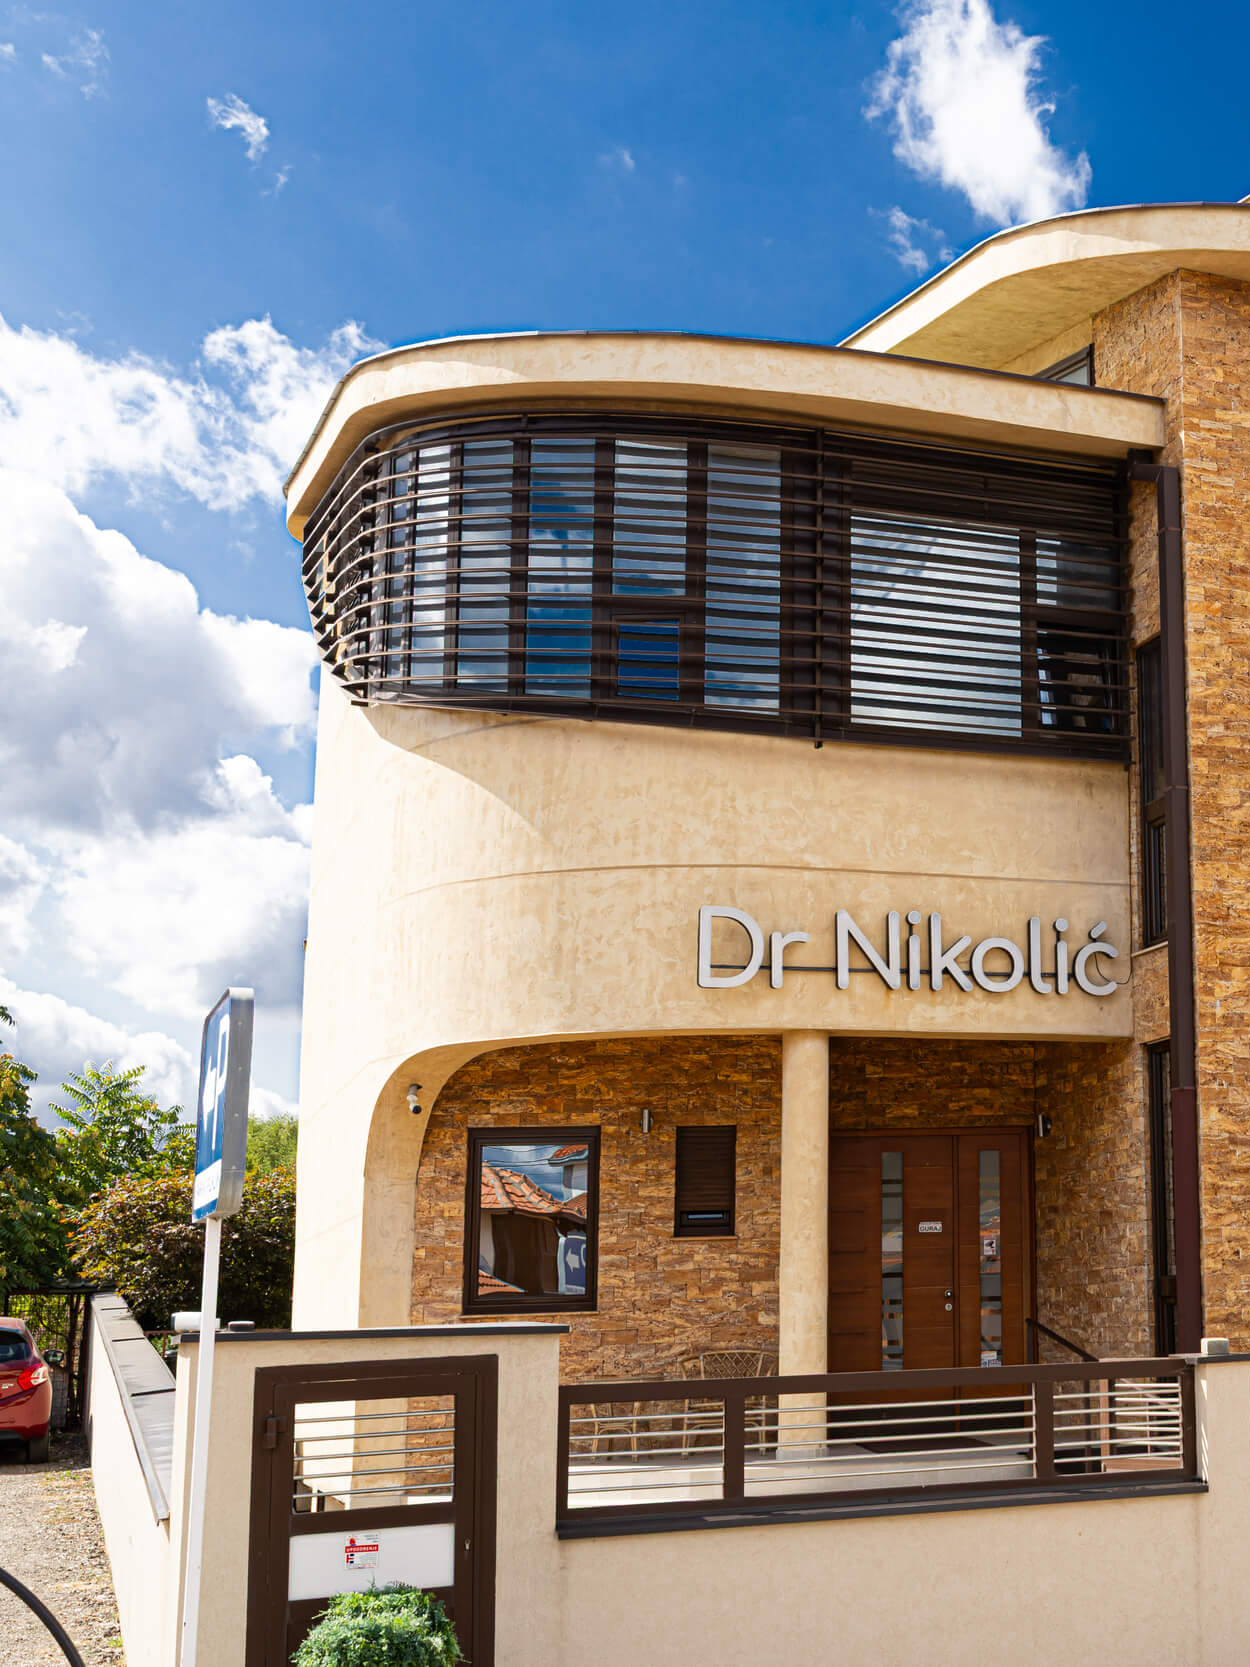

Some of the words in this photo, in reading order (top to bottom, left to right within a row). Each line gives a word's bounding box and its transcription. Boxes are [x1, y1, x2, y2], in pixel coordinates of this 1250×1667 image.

[698, 905, 811, 989] Dr
[834, 910, 1120, 996] Nikolić
[212, 1014, 230, 1151] P
